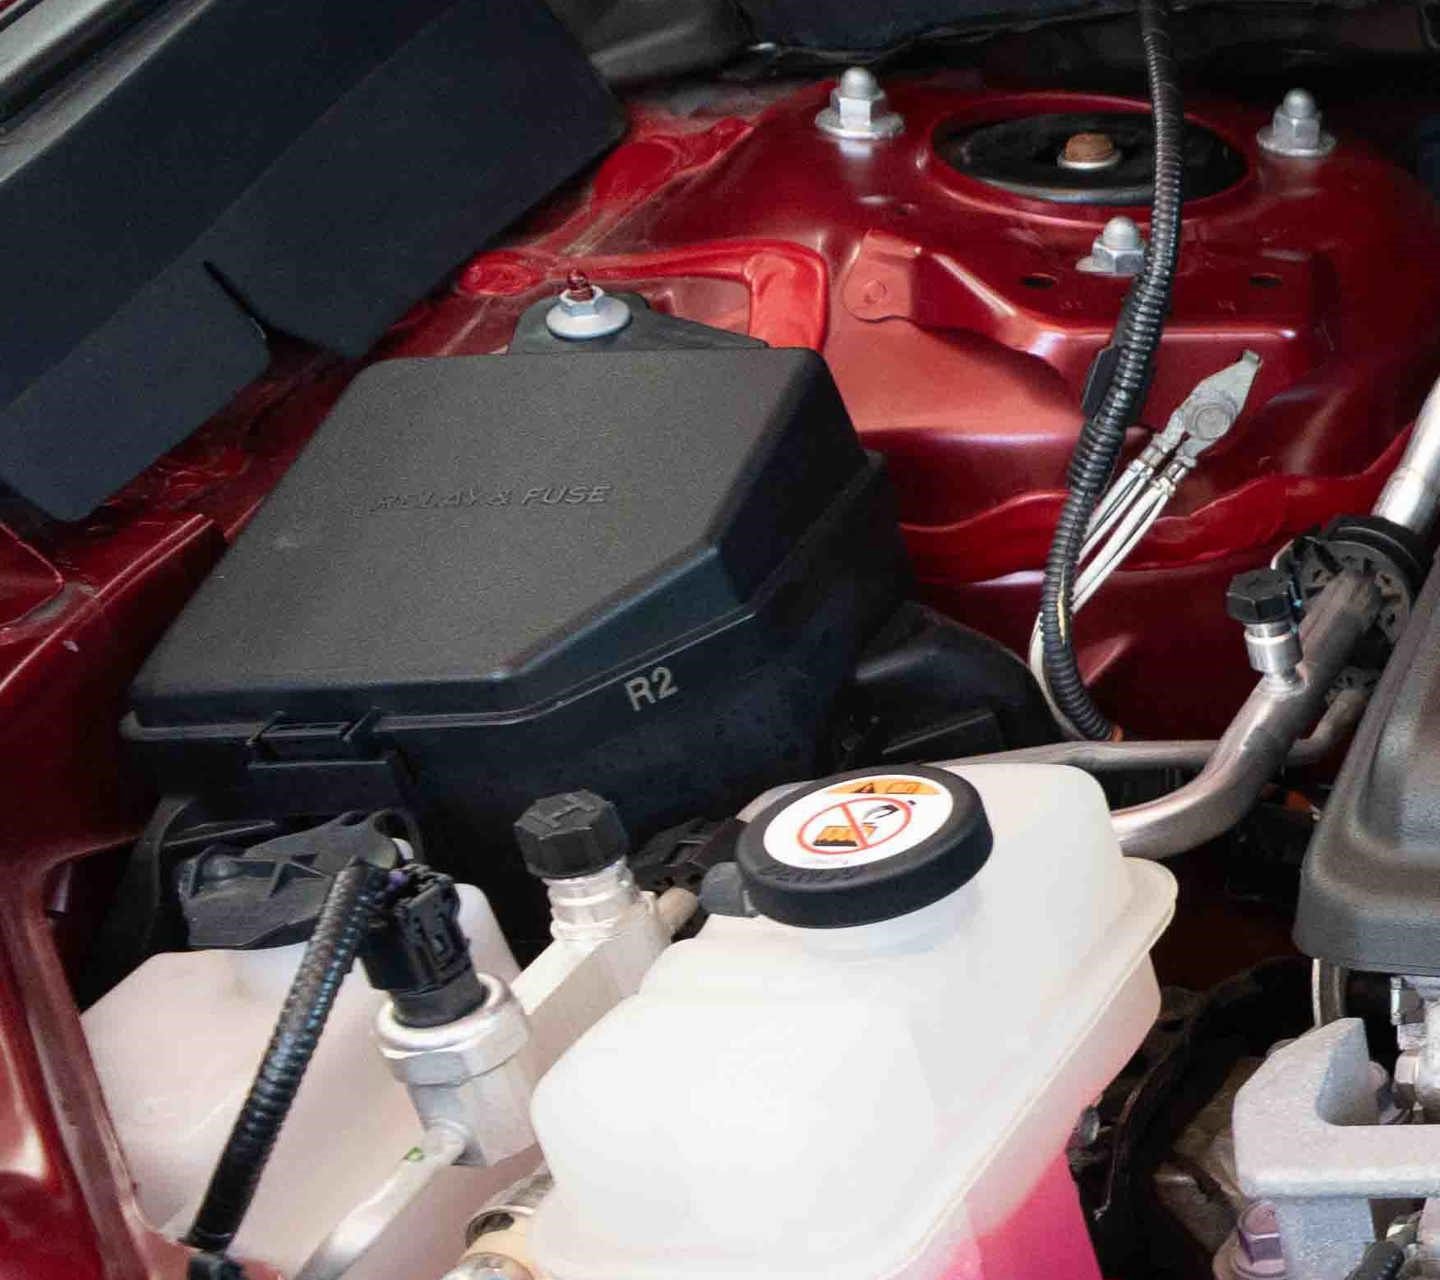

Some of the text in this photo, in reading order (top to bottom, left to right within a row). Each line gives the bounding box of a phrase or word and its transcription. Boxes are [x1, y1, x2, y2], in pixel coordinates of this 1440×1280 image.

[369, 488, 480, 513] RELAY
[520, 484, 611, 507] FUSE
[625, 666, 679, 712] R2
